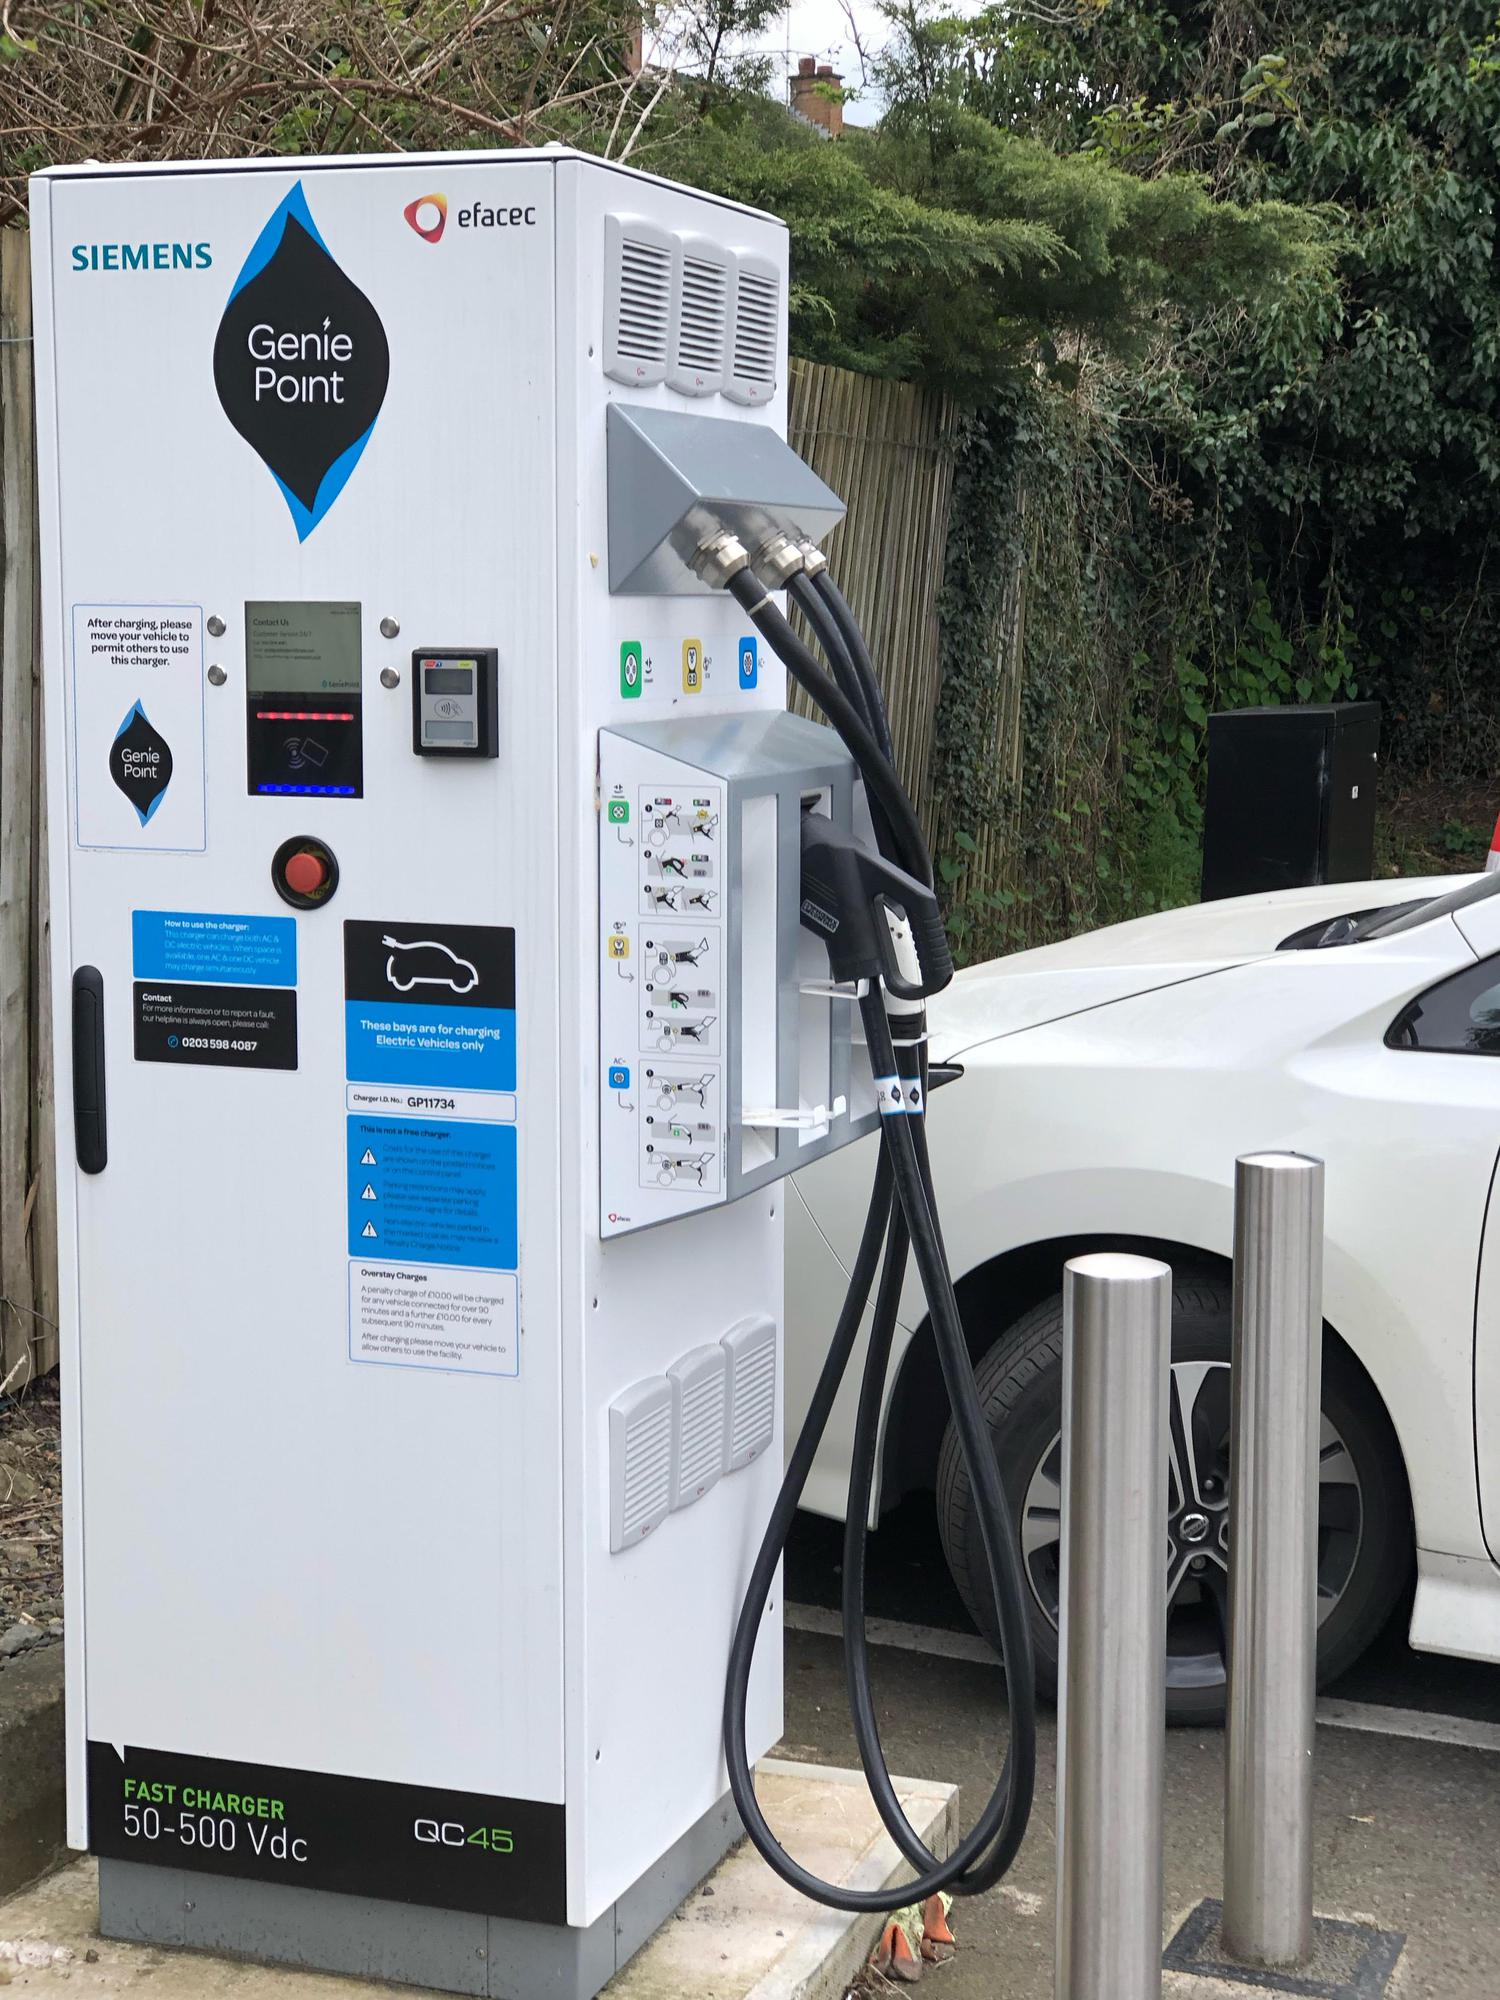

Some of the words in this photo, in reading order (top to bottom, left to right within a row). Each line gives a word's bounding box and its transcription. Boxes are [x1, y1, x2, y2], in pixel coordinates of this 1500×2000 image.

[458, 204, 536, 228] efacec
[72, 243, 212, 272] SIEMENS
[248, 318, 352, 362] Genie
[256, 366, 345, 403] Point
[87, 619, 112, 628] After
[114, 619, 158, 631] charging,
[160, 620, 192, 631] please
[91, 632, 117, 640] move
[119, 633, 141, 643] your
[143, 631, 177, 641] vehicle
[179, 632, 189, 641] to
[92, 644, 124, 655] permit
[126, 644, 158, 653] others
[160, 645, 170, 653] to
[111, 655, 129, 665] this
[130, 656, 170, 668] charger.
[121, 747, 160, 763] Genie
[124, 764, 157, 778] Point
[219, 923, 249, 931] charger:
[143, 994, 172, 1002] Contact
[155, 1016, 181, 1025] helpline
[189, 1018, 211, 1027] always
[233, 1020, 255, 1028] please
[259, 1011, 275, 1019] fault,
[360, 1020, 391, 1030] These
[393, 1022, 417, 1035] bays
[438, 1025, 453, 1034] for
[455, 1026, 500, 1040] charging
[182, 1038, 208, 1048] 0203
[210, 1040, 229, 1049] 598
[231, 1041, 257, 1050] 4087
[376, 1035, 415, 1046] Electric
[417, 1037, 460, 1048] Vehicles
[462, 1040, 484, 1053] only
[354, 1095, 378, 1104] Charger
[407, 1097, 455, 1109] GP11734
[361, 1270, 395, 1281] Overstay
[396, 1272, 427, 1282] Charges
[368, 1287, 393, 1297] penalty
[394, 1288, 418, 1298] charge
[464, 1293, 474, 1301] be
[475, 1295, 504, 1305] charged
[372, 1299, 384, 1307] any
[386, 1298, 410, 1306] vehicle
[412, 1302, 449, 1310] connected
[451, 1303, 460, 1311] for
[362, 1306, 389, 1315] minutes
[411, 1310, 435, 1318] further
[462, 1314, 471, 1322] for
[473, 1317, 492, 1326] every
[362, 1317, 403, 1328] subsequent
[362, 1333, 379, 1341] After
[380, 1334, 409, 1346] charging
[410, 1337, 432, 1346] please
[473, 1343, 497, 1351] vehicle
[380, 1345, 403, 1353] others
[426, 1348, 438, 1356] the
[440, 1349, 463, 1360] facility.
[124, 1779, 176, 1804] FAST
[182, 1789, 285, 1820] CHARGER
[123, 1804, 236, 1852] 50-500
[247, 1822, 308, 1862] Vdc
[414, 1819, 514, 1853] QC45
